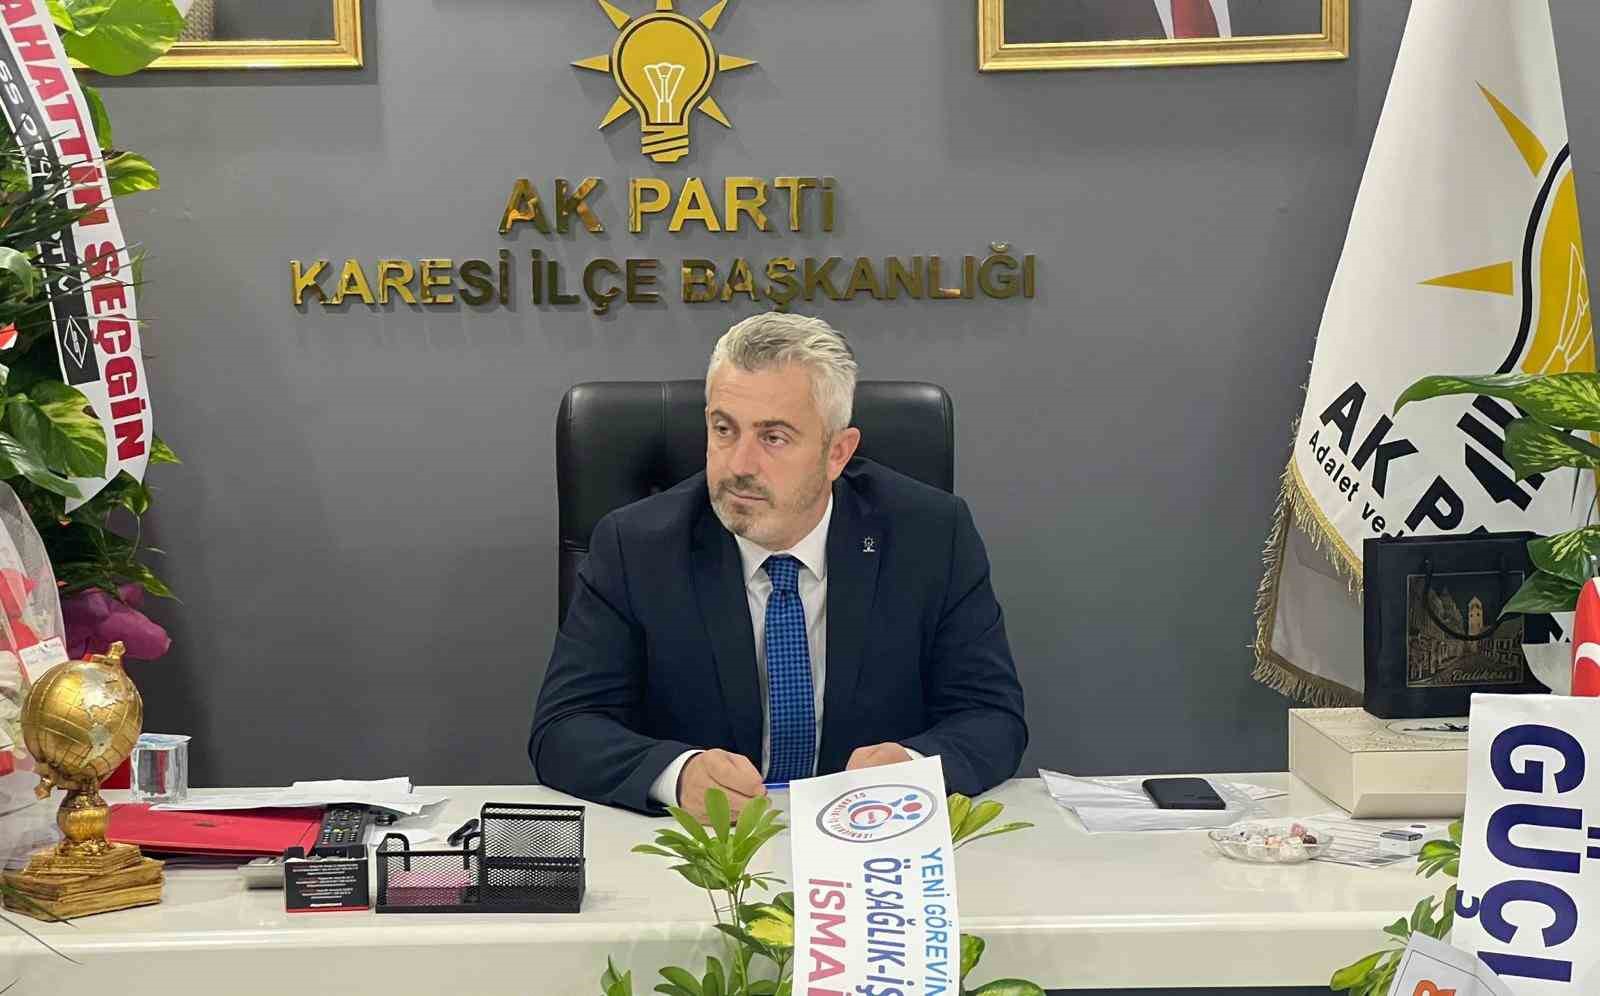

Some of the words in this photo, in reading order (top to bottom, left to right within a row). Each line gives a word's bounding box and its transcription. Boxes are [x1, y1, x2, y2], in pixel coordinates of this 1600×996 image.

[498, 176, 605, 233] AK
[290, 248, 509, 305] KARESİ
[531, 248, 658, 315] İLÇE
[681, 240, 1036, 311] BAŞKANLIĞI
[84, 240, 146, 462] SEÇGİN
[1308, 430, 1360, 502] Adalet
[1362, 502, 1386, 533] ve
[1319, 382, 1419, 499] AK
[920, 847, 950, 897] YENİ
